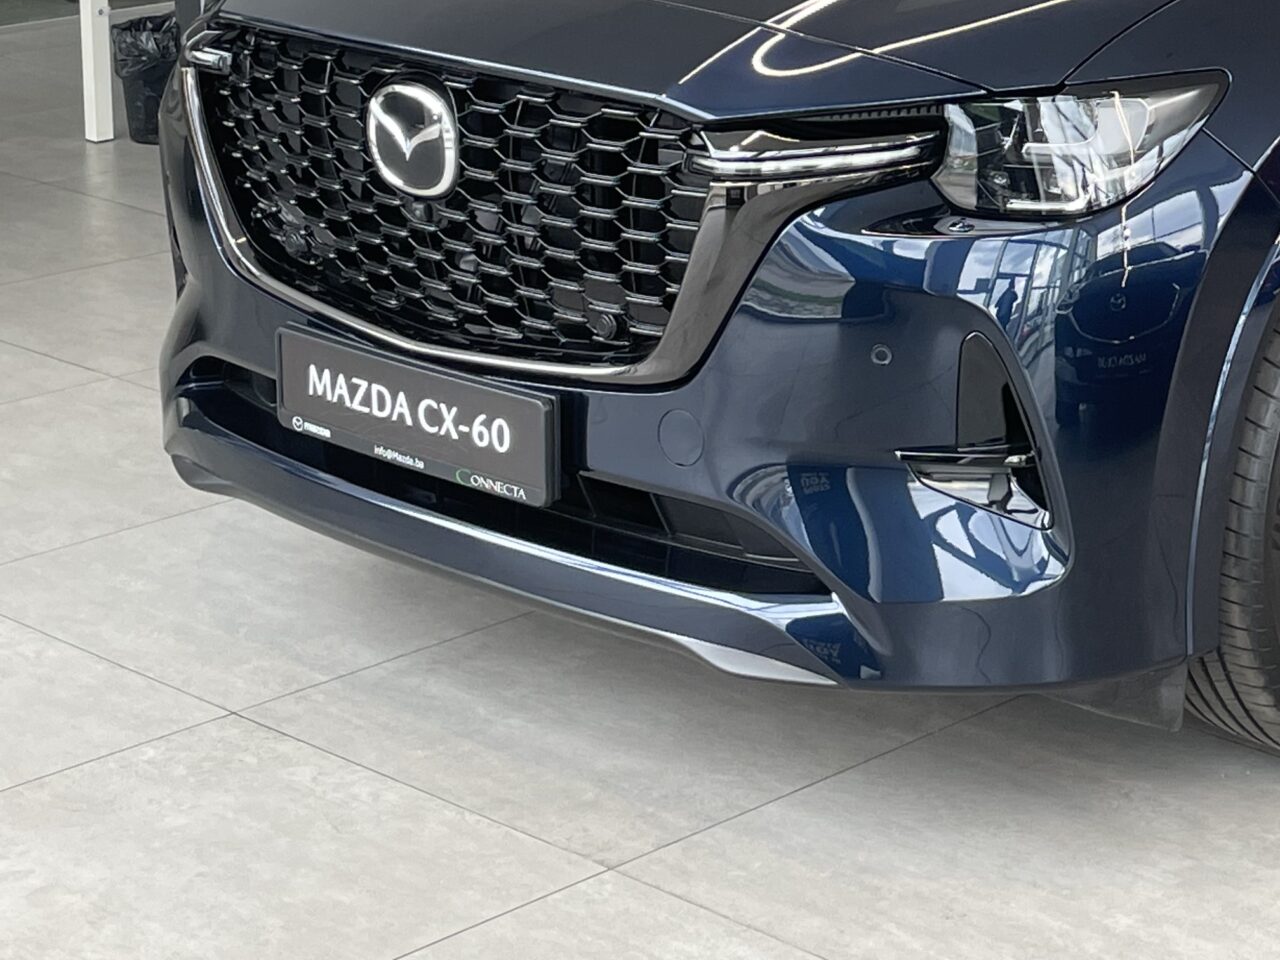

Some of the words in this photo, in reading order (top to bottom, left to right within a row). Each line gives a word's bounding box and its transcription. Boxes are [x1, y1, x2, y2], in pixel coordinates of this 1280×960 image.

[308, 363, 413, 427] MAZDA
[417, 398, 511, 453] CX-60
[455, 468, 527, 500] CONNECTA
